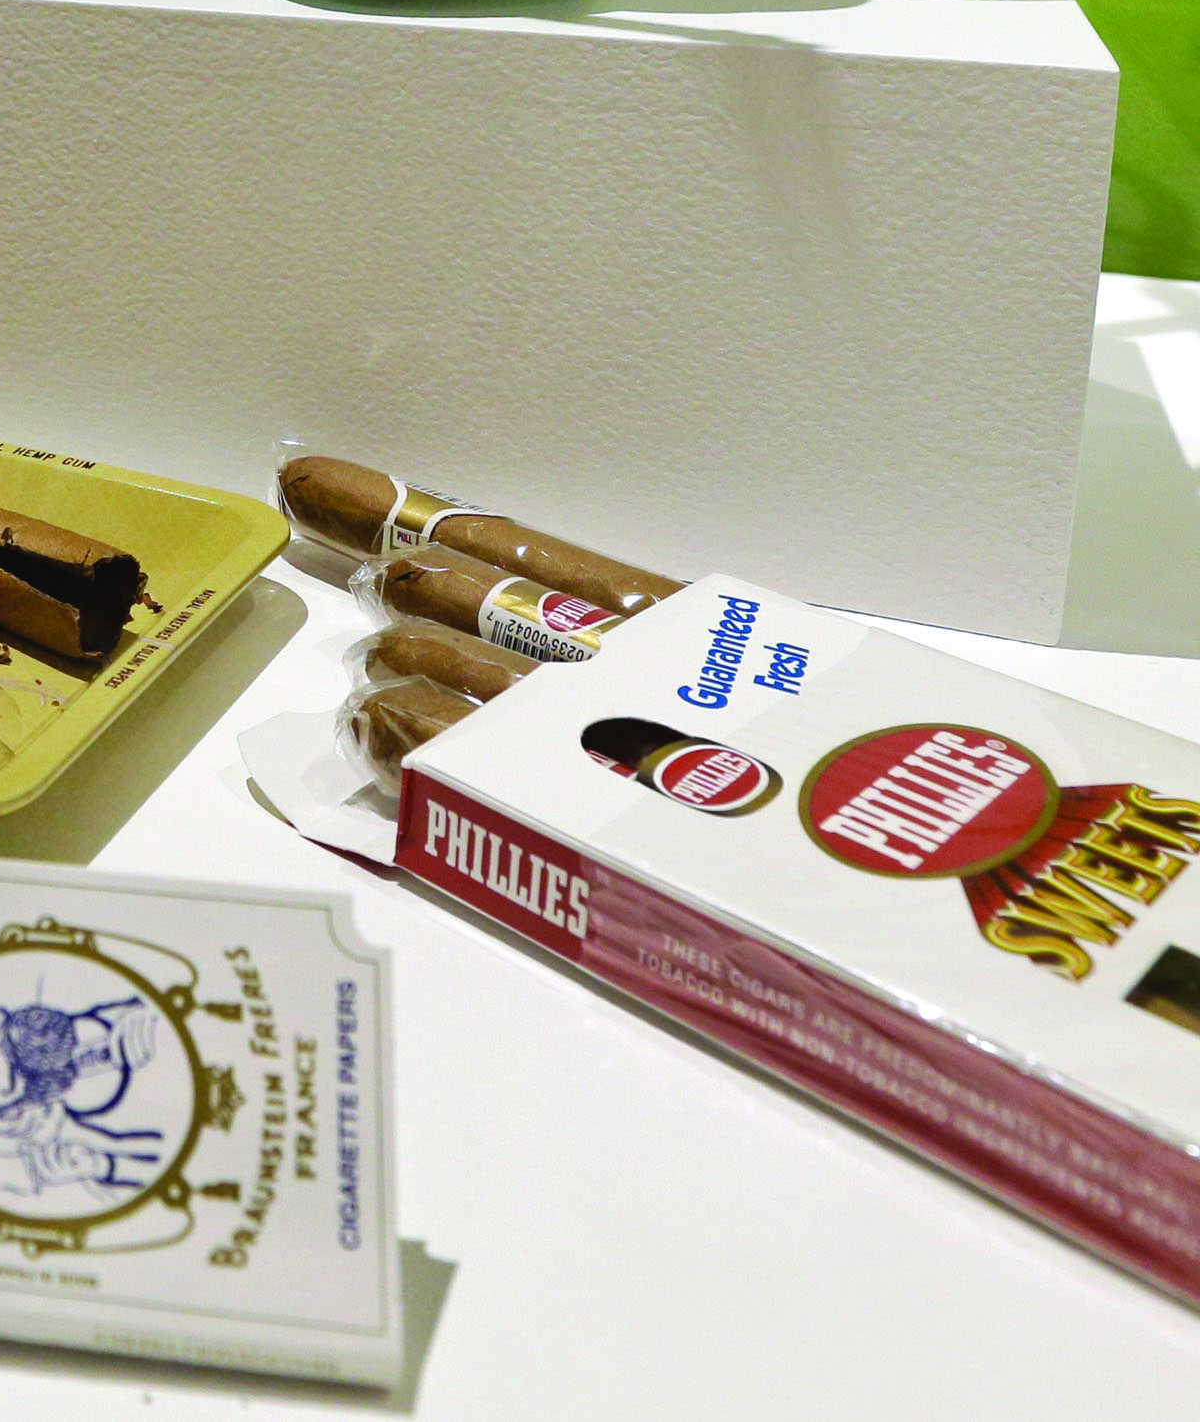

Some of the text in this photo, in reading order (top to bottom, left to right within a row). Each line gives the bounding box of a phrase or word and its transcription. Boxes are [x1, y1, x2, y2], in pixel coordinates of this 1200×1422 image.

[12, 447, 56, 461] HEMP
[61, 457, 96, 470] GUM
[486, 611, 494, 621] 7
[507, 619, 549, 646] 00042
[677, 594, 760, 709] Guaranteed
[753, 642, 810, 695] Fresh
[671, 751, 753, 804] PHILLIES
[819, 730, 1033, 870] PHILLIES
[425, 798, 591, 940] PHILLIES
[980, 784, 1200, 983] SWEETS
[637, 947, 724, 1006] TOBACCO
[730, 998, 785, 1037] WITH
[663, 934, 722, 977] THESE
[728, 969, 807, 1021] CIGARS
[295, 1037, 318, 1180] FRANCE
[335, 980, 361, 1251] CIGARETTE PAPERS
[208, 1074, 286, 1268] BRAUNSTEIN
